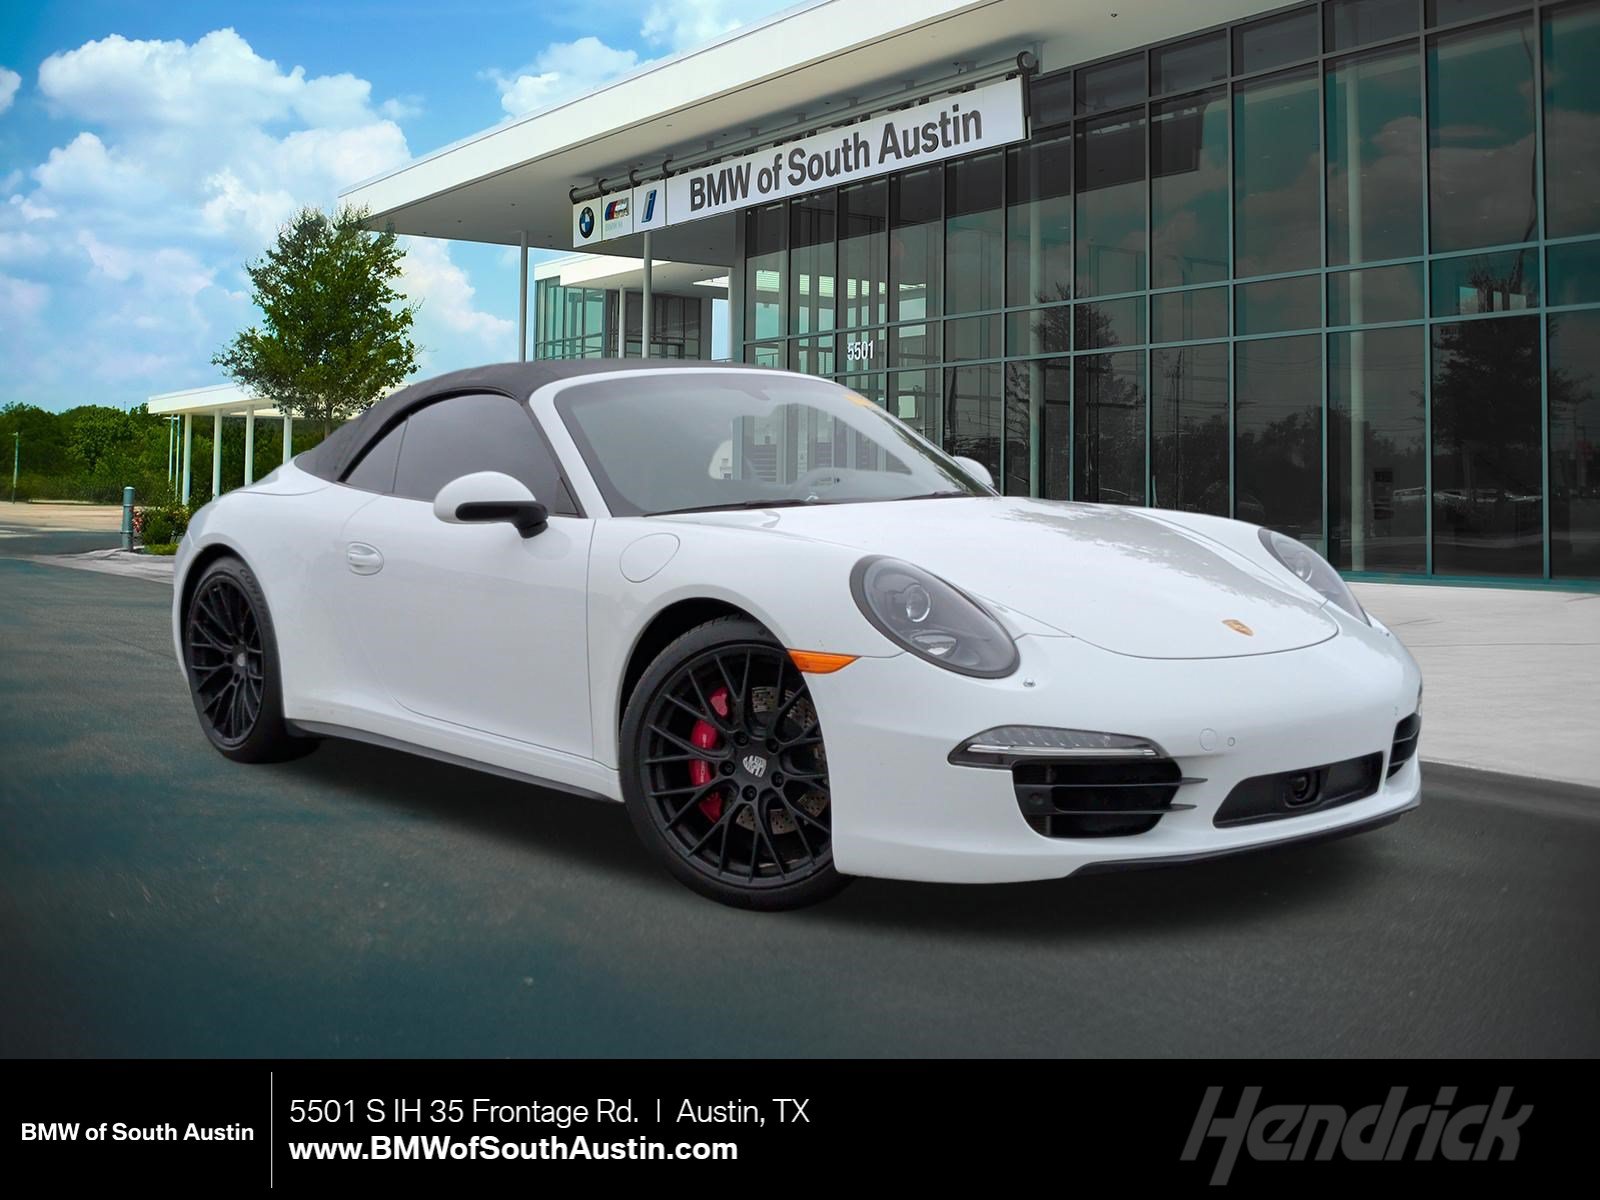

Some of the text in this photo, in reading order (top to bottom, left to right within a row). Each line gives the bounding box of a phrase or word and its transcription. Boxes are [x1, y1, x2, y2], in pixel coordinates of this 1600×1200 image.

[690, 162, 752, 211] BMW
[757, 153, 783, 194] of
[787, 132, 871, 187] South
[878, 104, 983, 165] Austin
[847, 340, 874, 360] 5501
